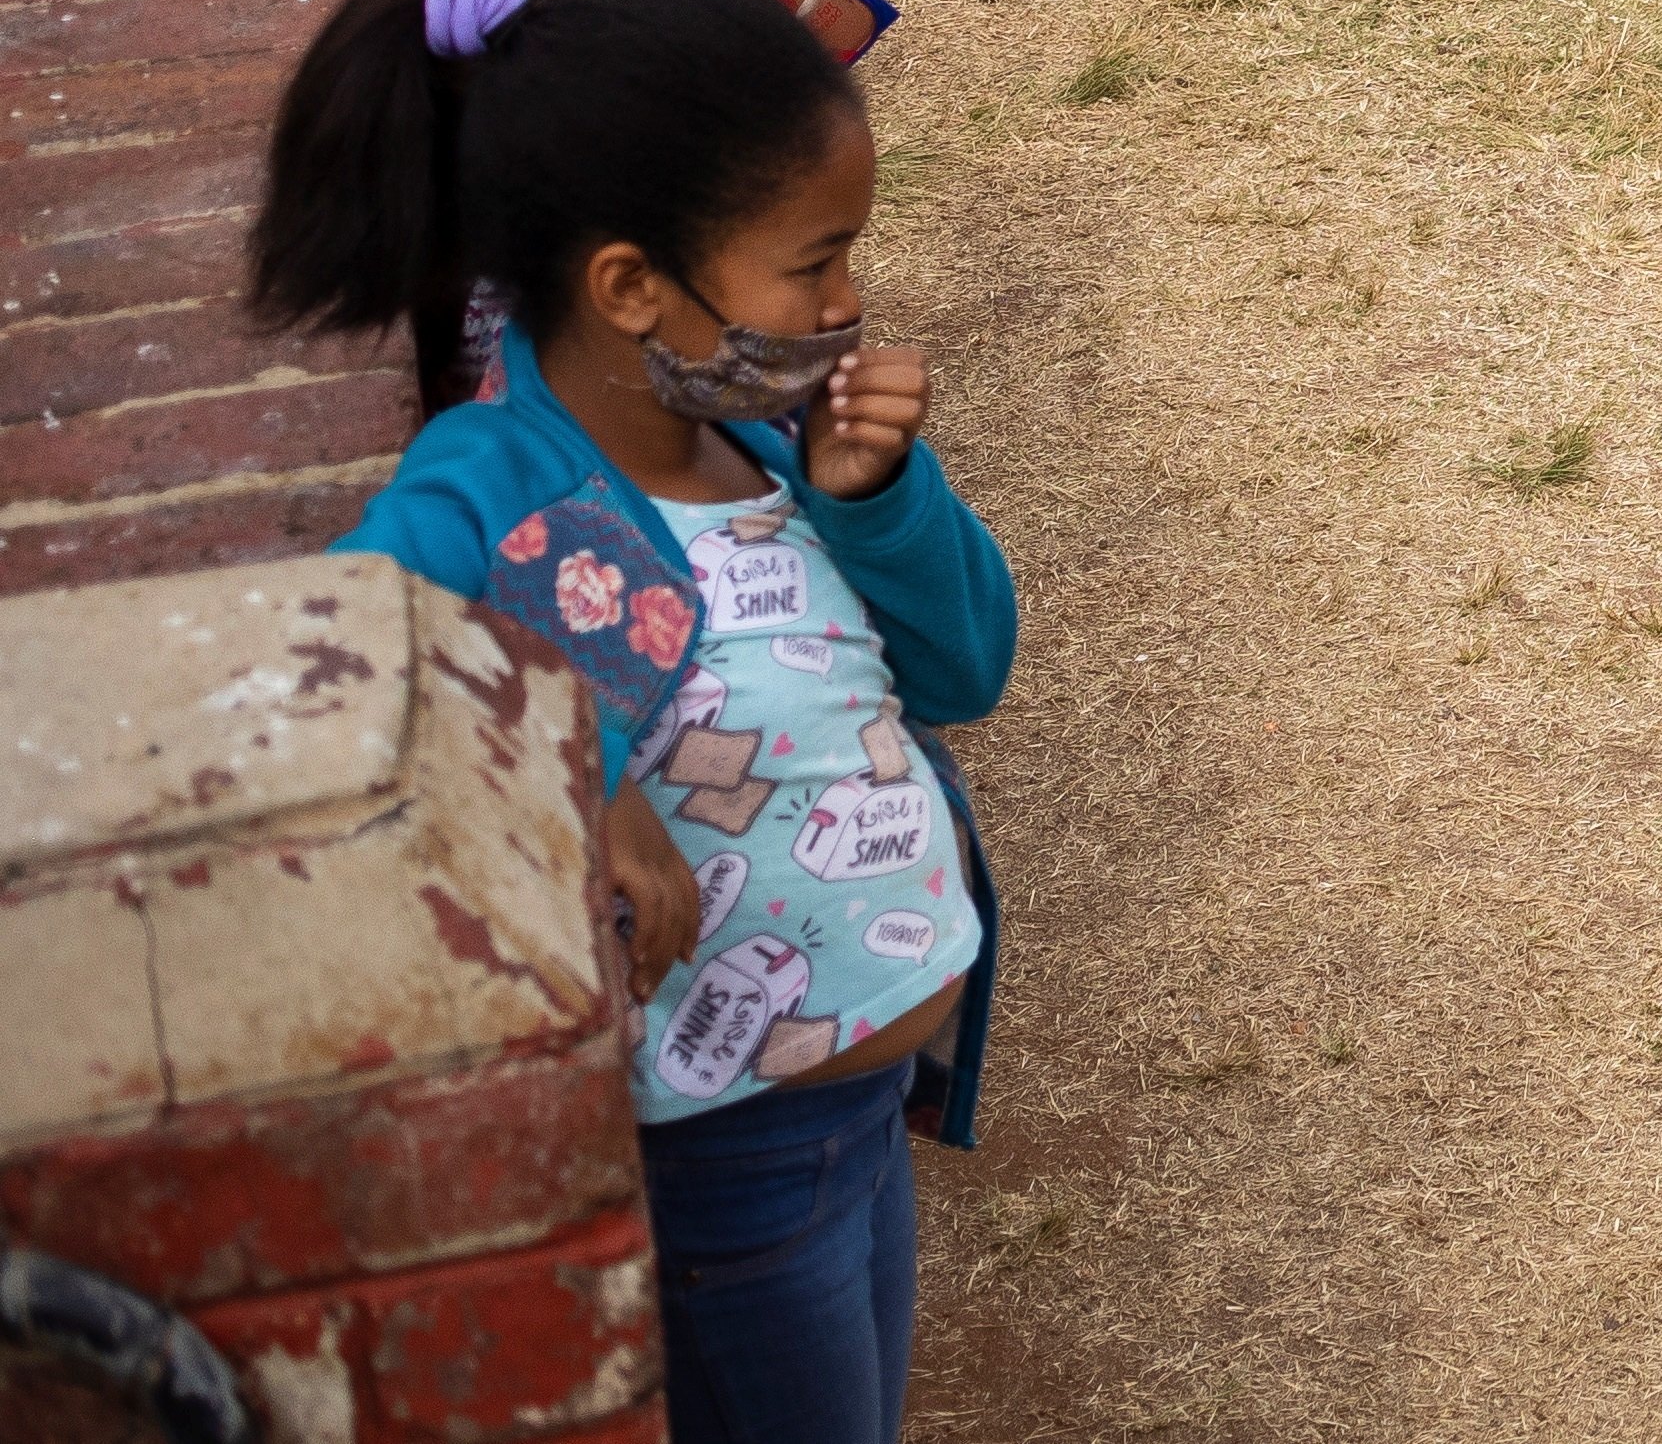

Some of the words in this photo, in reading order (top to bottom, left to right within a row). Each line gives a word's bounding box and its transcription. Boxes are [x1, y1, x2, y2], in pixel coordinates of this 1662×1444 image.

[733, 585, 798, 620] SHINE
[847, 828, 920, 869] SHINE
[667, 982, 731, 1070] SHINE
